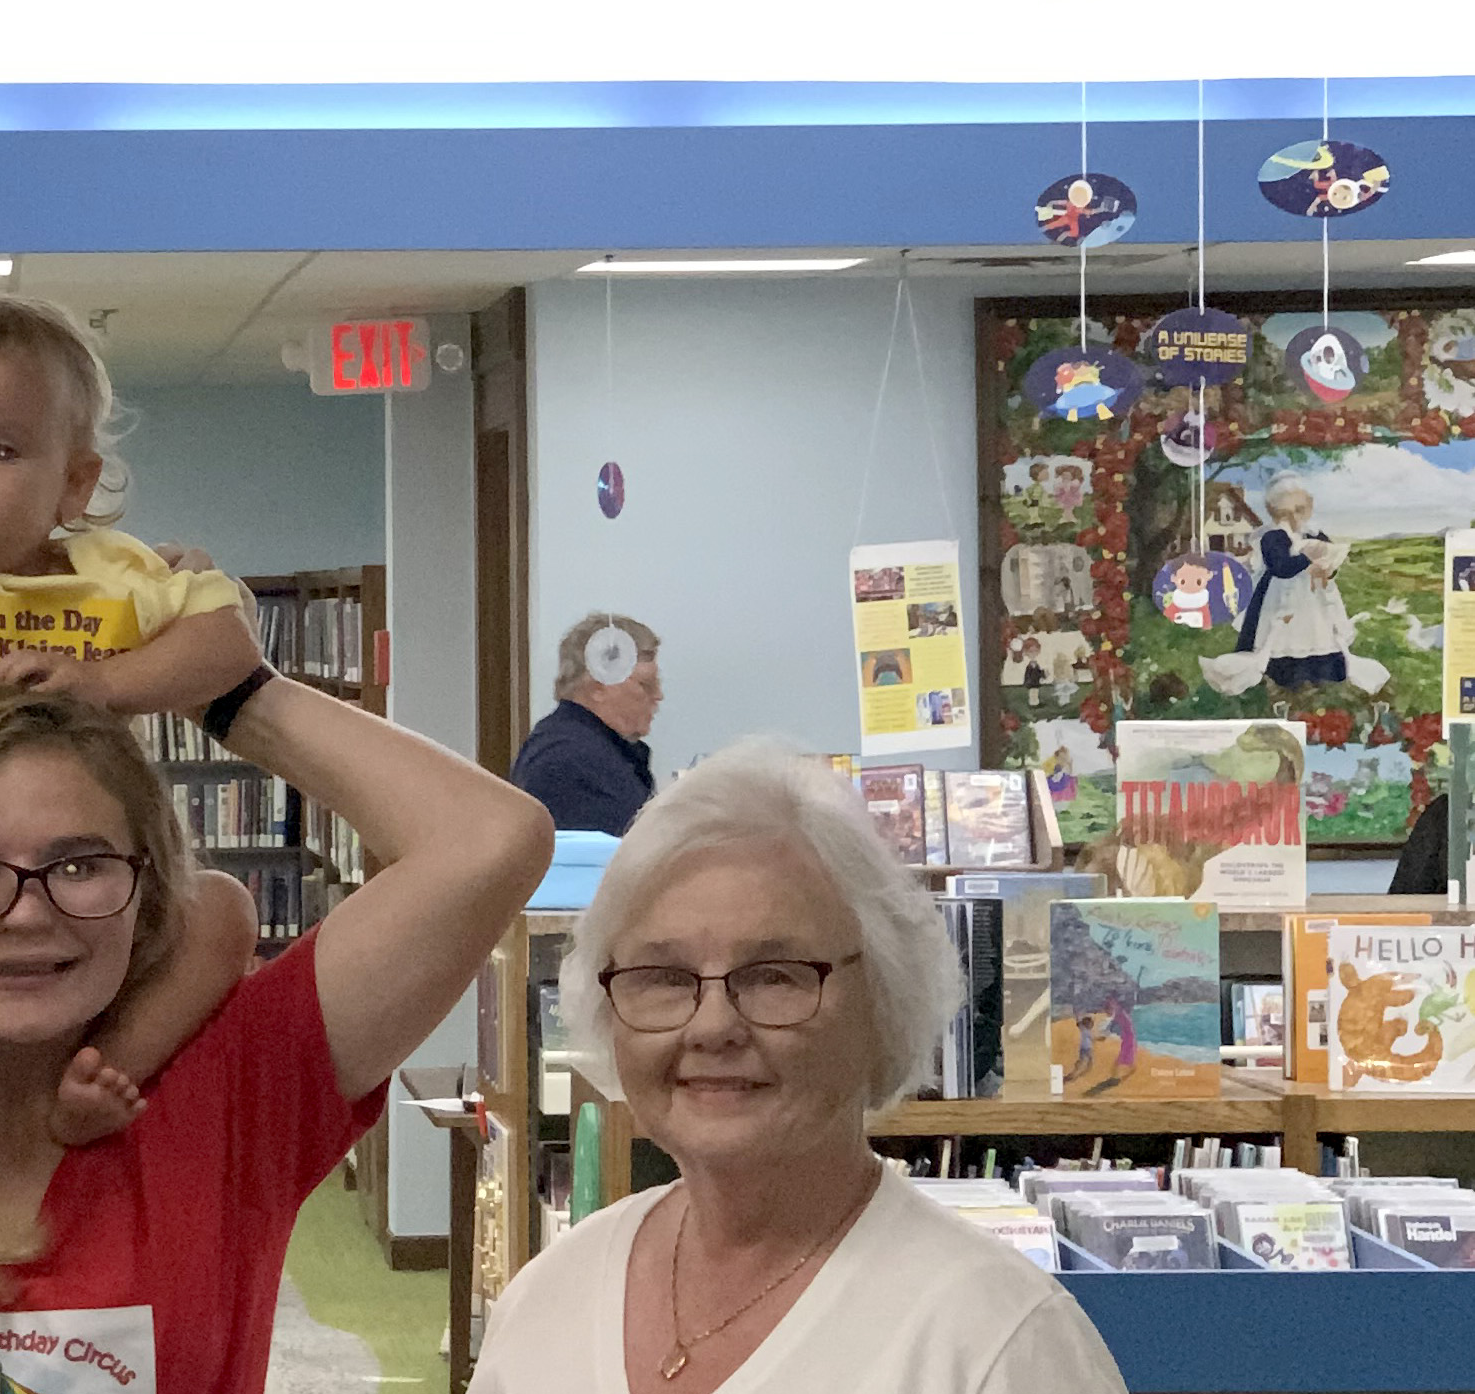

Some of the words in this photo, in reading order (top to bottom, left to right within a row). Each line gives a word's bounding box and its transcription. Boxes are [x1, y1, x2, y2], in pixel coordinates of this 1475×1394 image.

[1158, 330, 1168, 344] A
[1173, 331, 1247, 347] UNIVERSE
[332, 320, 414, 389] EXIT
[1158, 346, 1179, 360] OF
[1184, 347, 1246, 363] STORIES
[15, 609, 55, 631] the
[62, 609, 103, 637] Day
[1119, 780, 1302, 846] TITANOSAUR
[1355, 935, 1443, 963] HELLO
[64, 1338, 137, 1386] Circus
